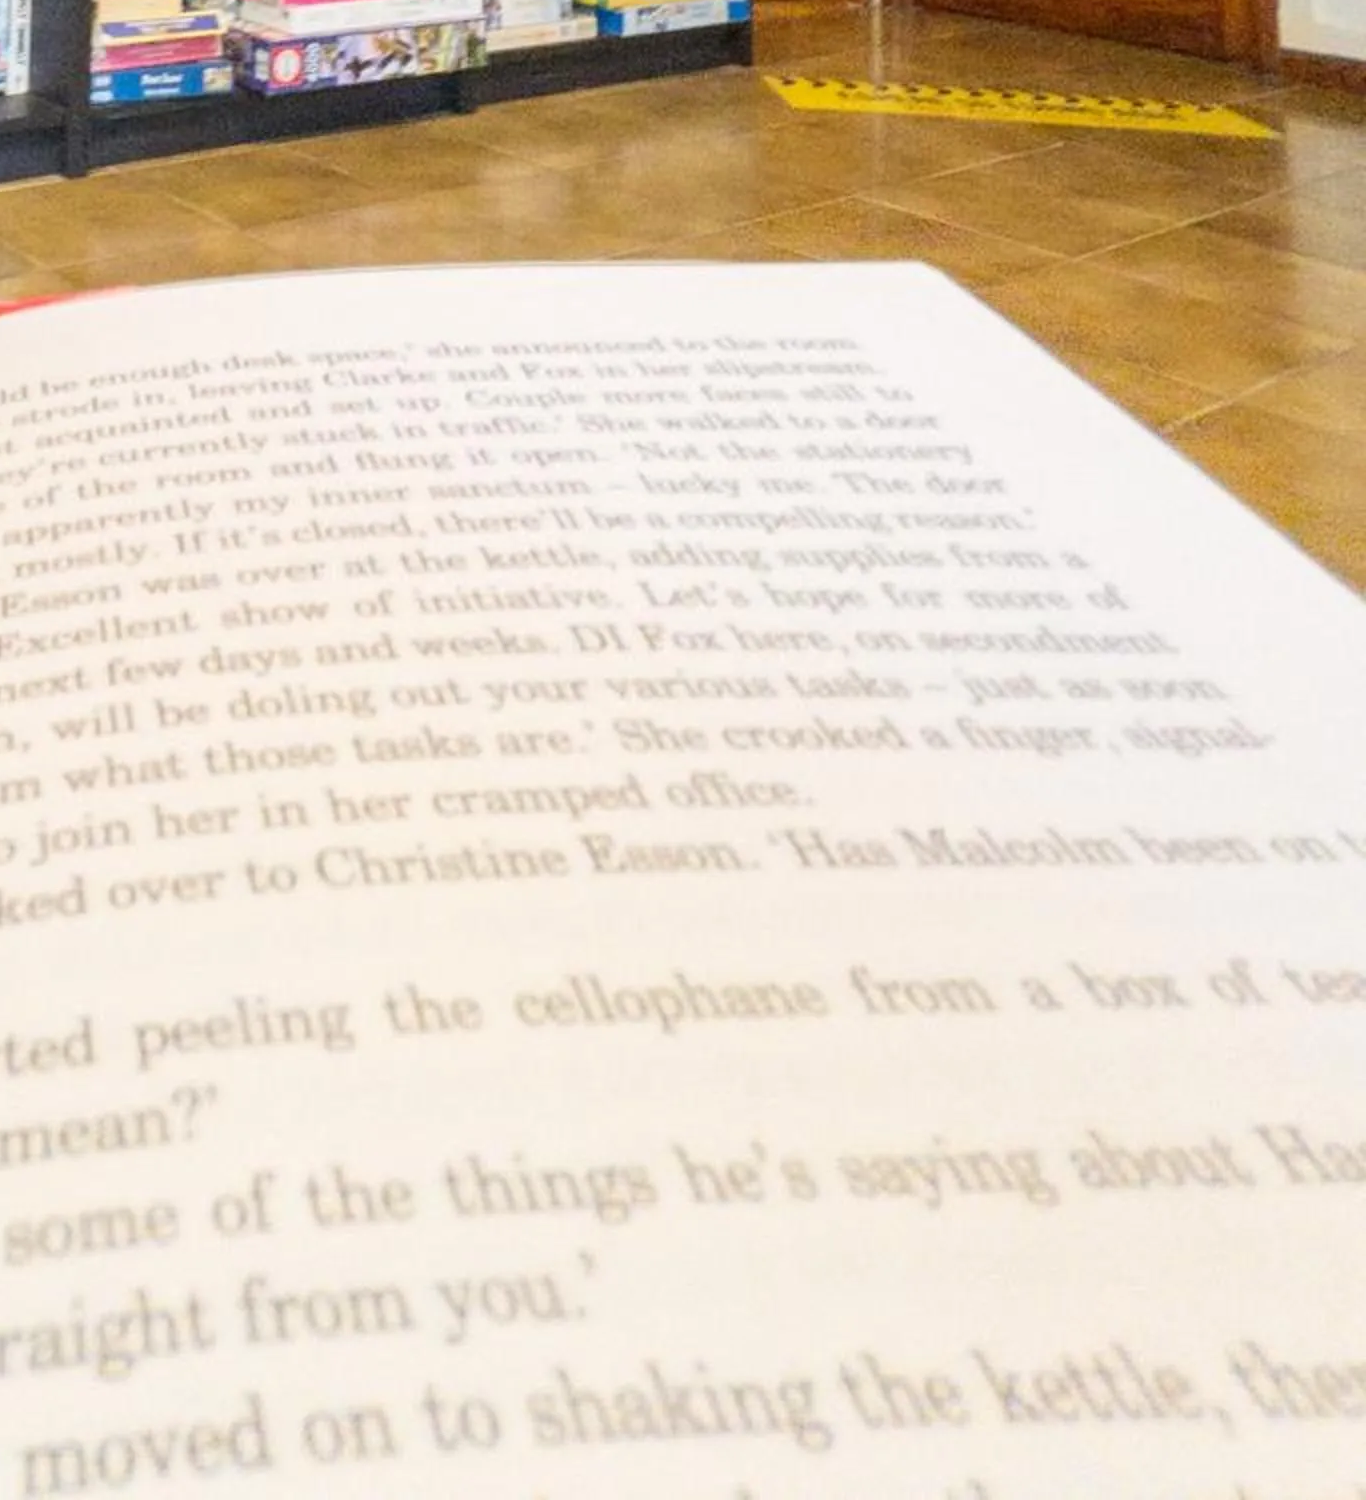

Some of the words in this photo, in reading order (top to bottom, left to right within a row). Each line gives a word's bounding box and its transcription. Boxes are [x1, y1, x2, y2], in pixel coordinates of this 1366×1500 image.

[2, 497, 214, 548] apparently
[140, 572, 222, 596] was
[235, 560, 326, 586] over
[343, 553, 385, 579] at
[220, 599, 329, 630] show
[353, 588, 394, 618] of
[1085, 582, 1130, 612] of
[106, 656, 183, 687] few
[197, 644, 303, 678] days
[315, 631, 400, 666] and
[51, 701, 136, 742] will
[154, 697, 209, 729] be
[227, 684, 378, 721] doling
[389, 677, 471, 708] out
[482, 677, 588, 712] your
[62, 751, 187, 793] what
[202, 740, 336, 777] those
[350, 724, 483, 765] tasks
[611, 717, 708, 753] She
[30, 818, 132, 868] join
[151, 802, 240, 841] her
[259, 800, 310, 831] in
[325, 786, 412, 825] her
[431, 771, 651, 822] cramped
[665, 770, 815, 809] office.
[107, 869, 226, 910] over
[243, 859, 299, 896] to
[313, 845, 568, 889] Christine
[578, 832, 760, 876] Esson.
[134, 995, 357, 1073] peeling
[382, 982, 483, 1036] the
[513, 970, 829, 1036] cellophane
[848, 964, 999, 1016] from
[3, 1202, 180, 1268] some
[210, 1169, 277, 1237] of
[304, 1164, 415, 1229] the
[442, 1153, 659, 1225] things
[671, 1139, 821, 1205] he's
[837, 1135, 1061, 1212] saying
[238, 1274, 416, 1345] from
[434, 1248, 598, 1348] you.'
[20, 1390, 276, 1500] moved
[301, 1405, 399, 1465] on
[420, 1382, 504, 1454] to
[525, 1359, 836, 1454] shaking
[838, 1348, 974, 1431] the
[972, 1342, 1233, 1435] kettle,
